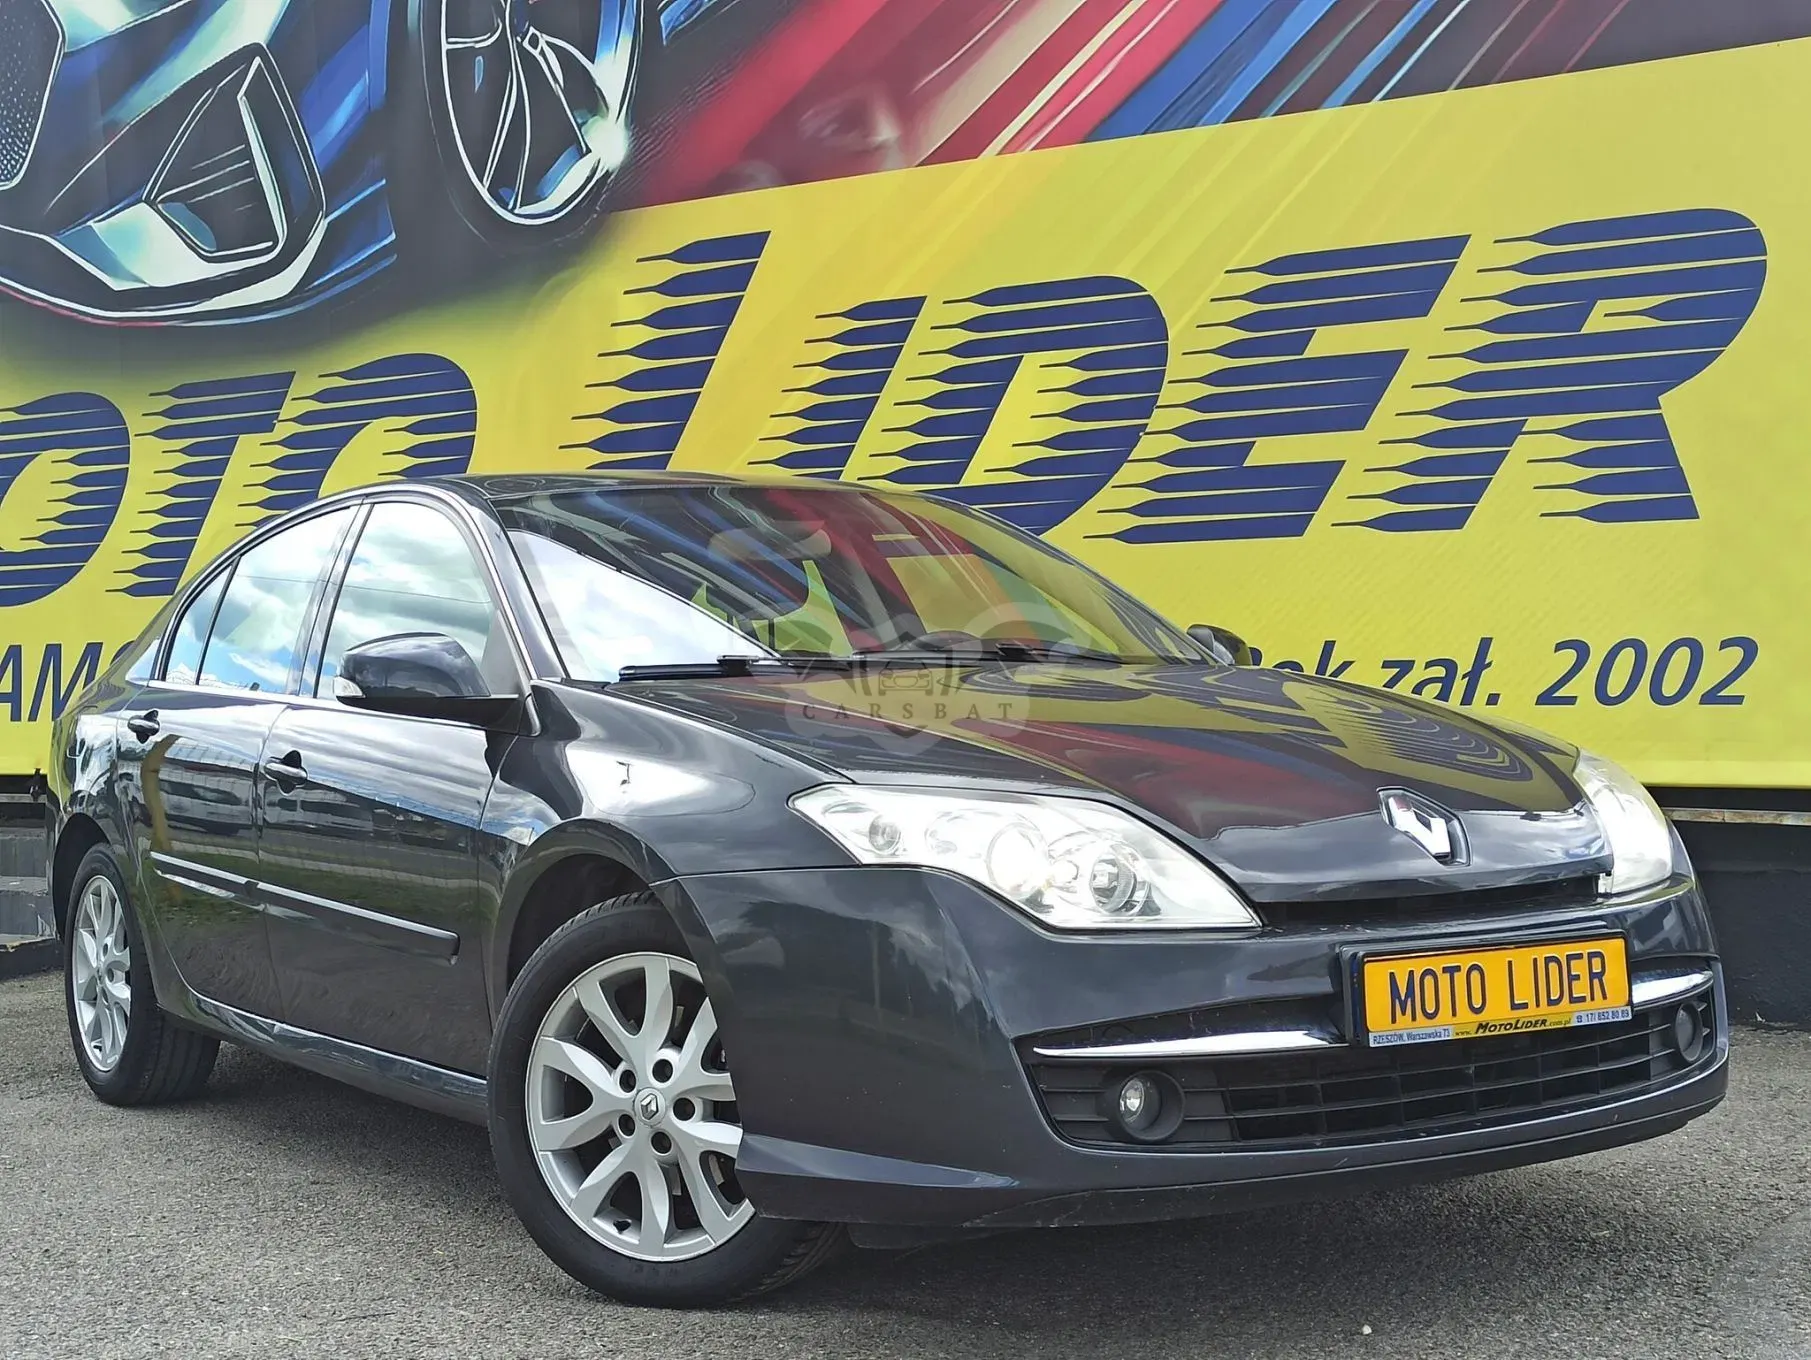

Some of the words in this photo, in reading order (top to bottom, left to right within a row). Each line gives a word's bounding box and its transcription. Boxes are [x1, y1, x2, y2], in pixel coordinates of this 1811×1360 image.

[559, 208, 1768, 543] LIDER
[1380, 637, 1501, 706] zał.
[1534, 636, 1759, 706] 2002
[1388, 963, 1488, 1025] MOTO
[1507, 950, 1609, 1011] LIDER
